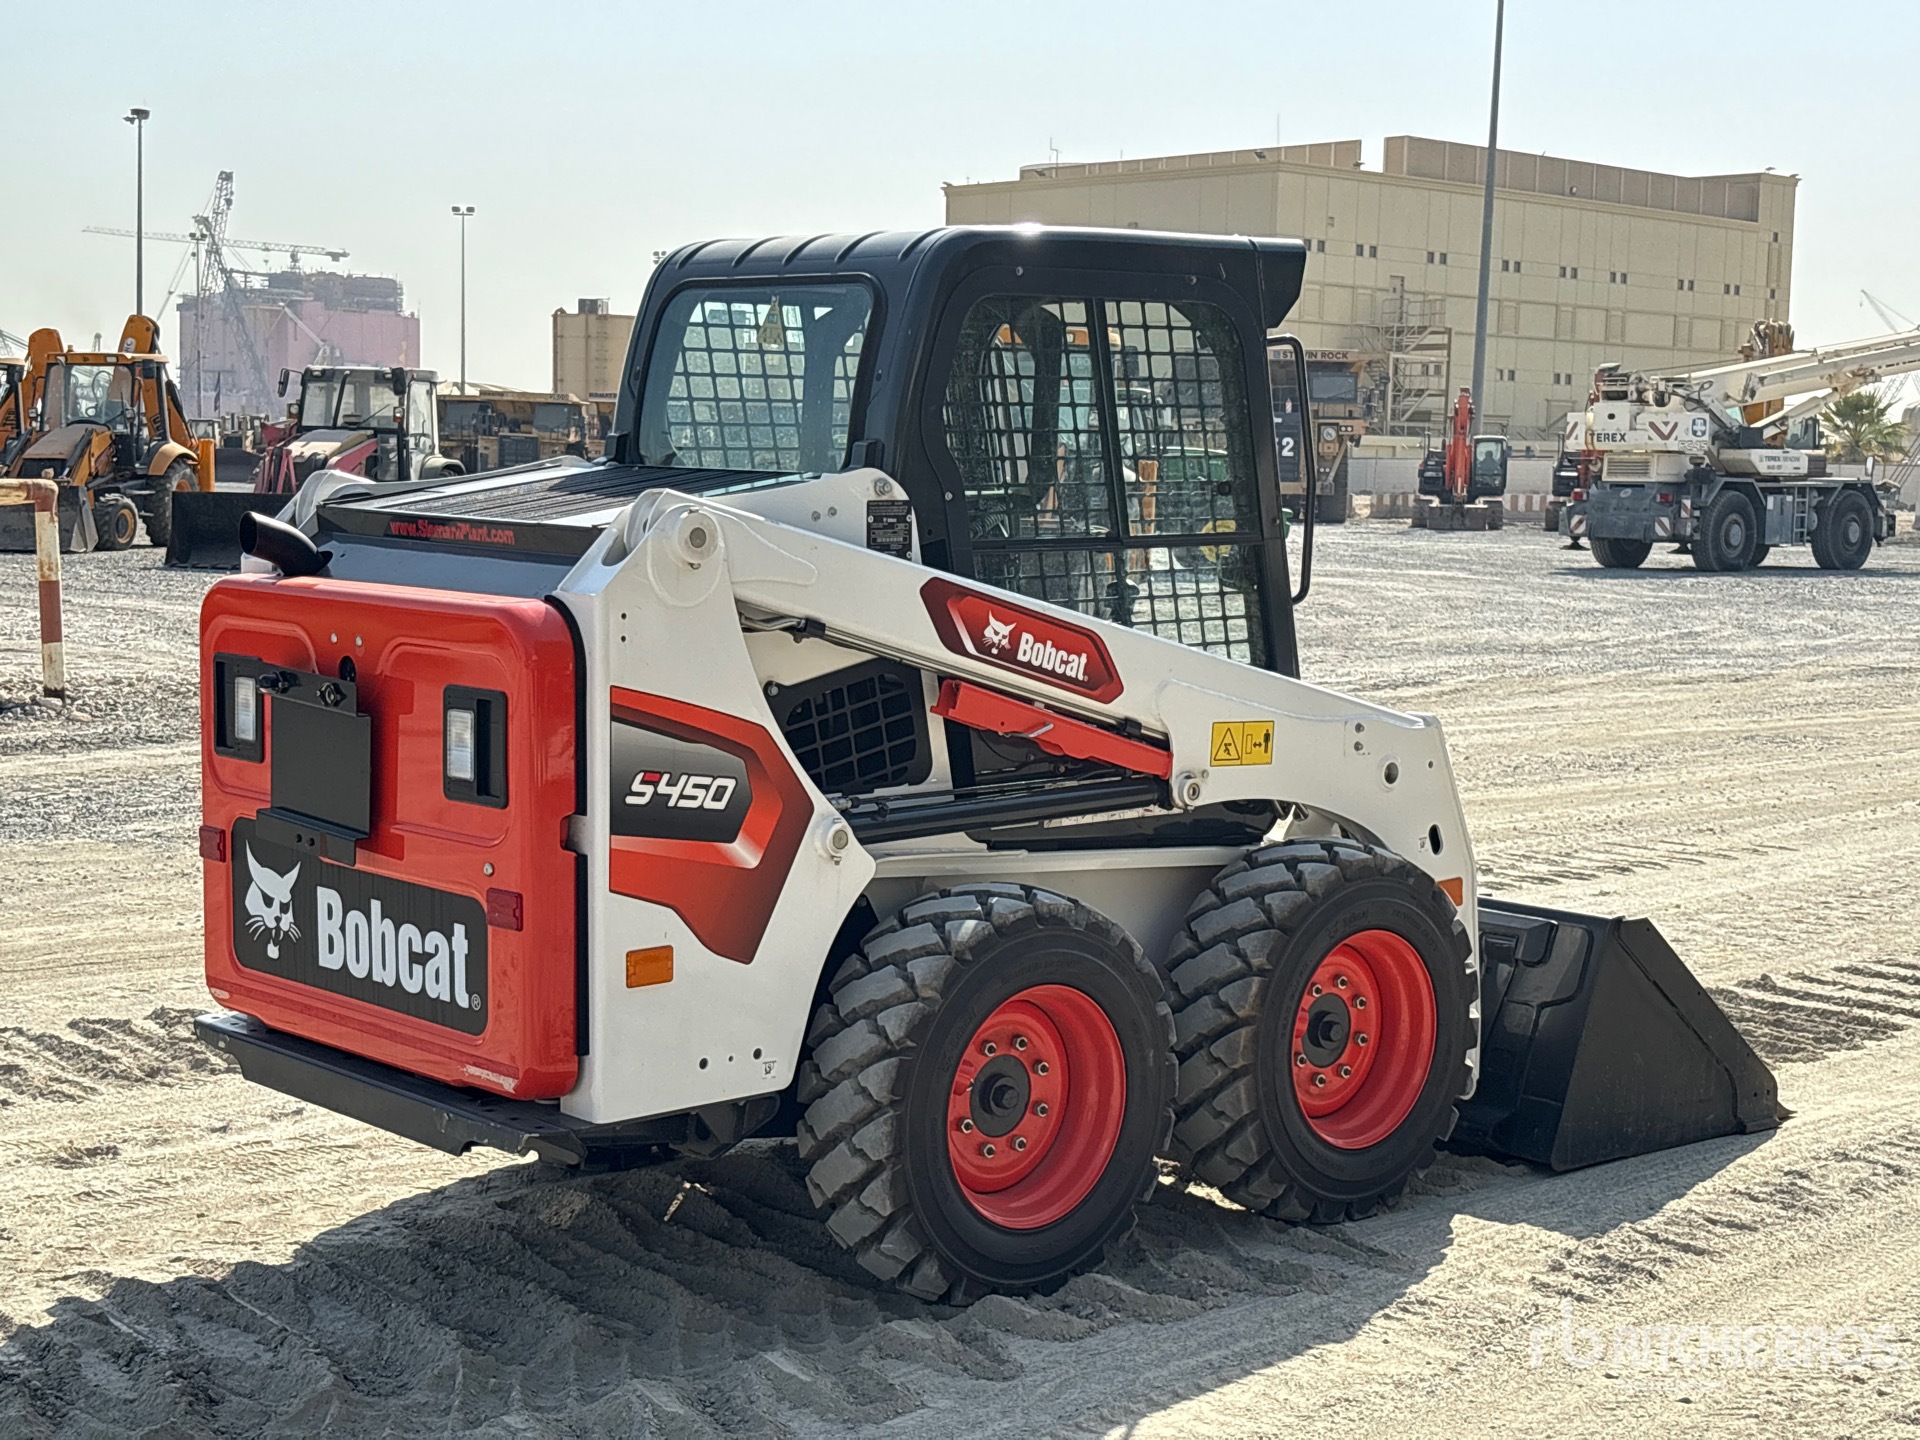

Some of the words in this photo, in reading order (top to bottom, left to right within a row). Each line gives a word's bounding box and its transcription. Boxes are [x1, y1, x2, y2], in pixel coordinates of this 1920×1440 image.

[1282, 351, 1318, 360] STIN
[1320, 351, 1349, 360] ROCK
[1589, 432, 1627, 443] TEREX
[1016, 631, 1088, 682] Bobcat
[624, 771, 738, 811] S450
[316, 885, 470, 1009] Bobcat
